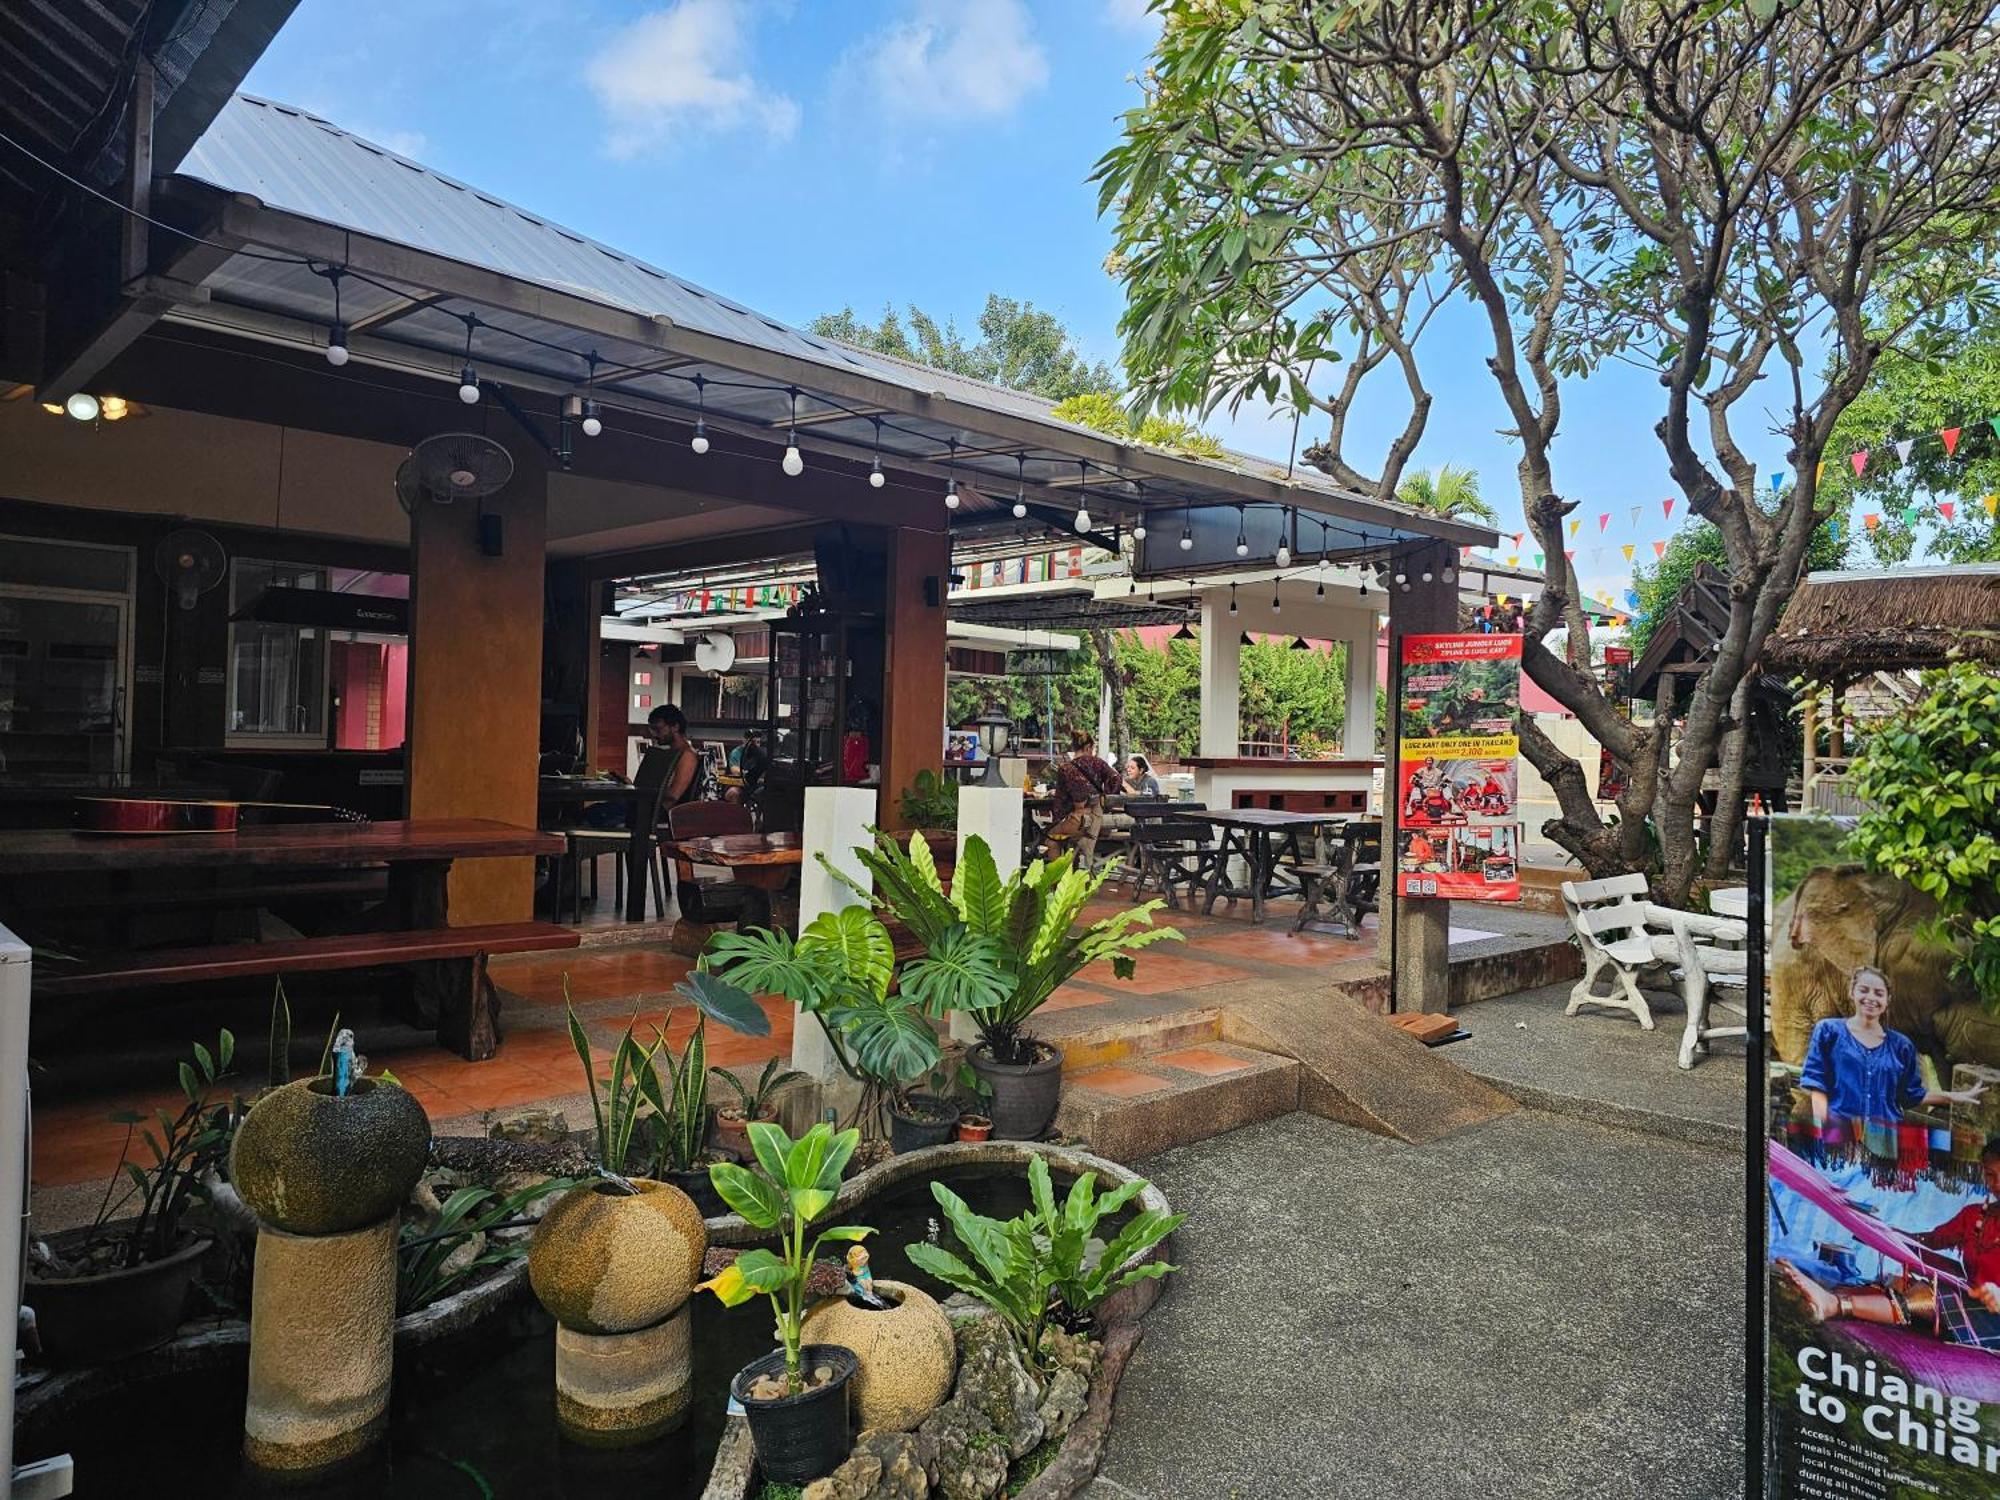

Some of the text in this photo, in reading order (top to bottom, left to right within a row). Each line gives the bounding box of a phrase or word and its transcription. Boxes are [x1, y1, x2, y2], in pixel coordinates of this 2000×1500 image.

[1482, 738, 1514, 747] THAILAND
[1796, 1383, 1846, 1424] to
[1797, 1346, 1981, 1434] Chiang
[1800, 1427, 1889, 1464] Access to all sites
[1799, 1468, 1833, 1487] during
[1835, 1480, 1848, 1490] all
[1800, 1442, 1831, 1456] meals
[1834, 1450, 1881, 1477] including
[1883, 1468, 1926, 1490] lunches
[1802, 1455, 1887, 1493] local restaurants
[1800, 1483, 1823, 1497] Free
